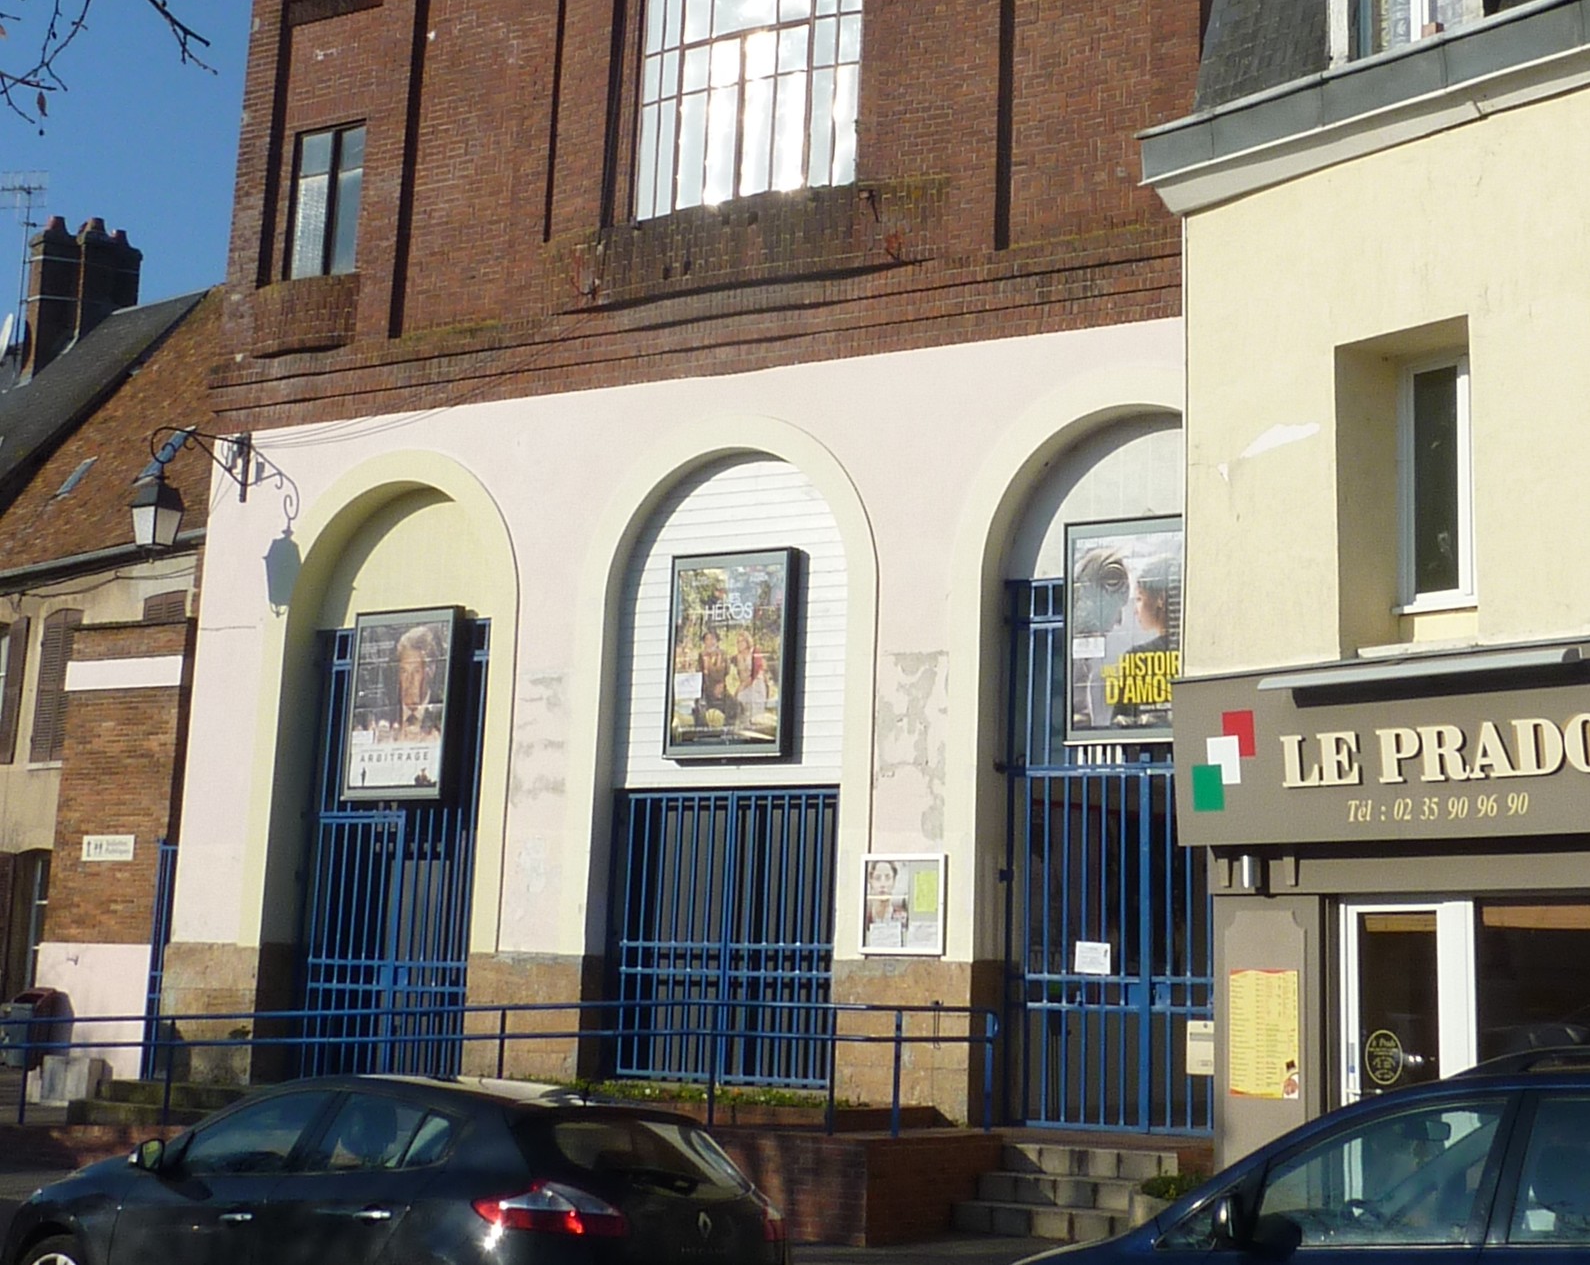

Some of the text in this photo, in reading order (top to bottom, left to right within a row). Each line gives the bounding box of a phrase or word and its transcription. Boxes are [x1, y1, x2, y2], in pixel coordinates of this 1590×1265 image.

[360, 751, 429, 763] ARBITRAGE
[1280, 713, 1590, 788] LE PRADO
[1347, 799, 1372, 822] Tél
[1393, 798, 1413, 820] 02
[1420, 797, 1440, 820] 35
[1447, 796, 1469, 820] 90
[1476, 794, 1498, 818] 96
[1507, 792, 1529, 816] 90
